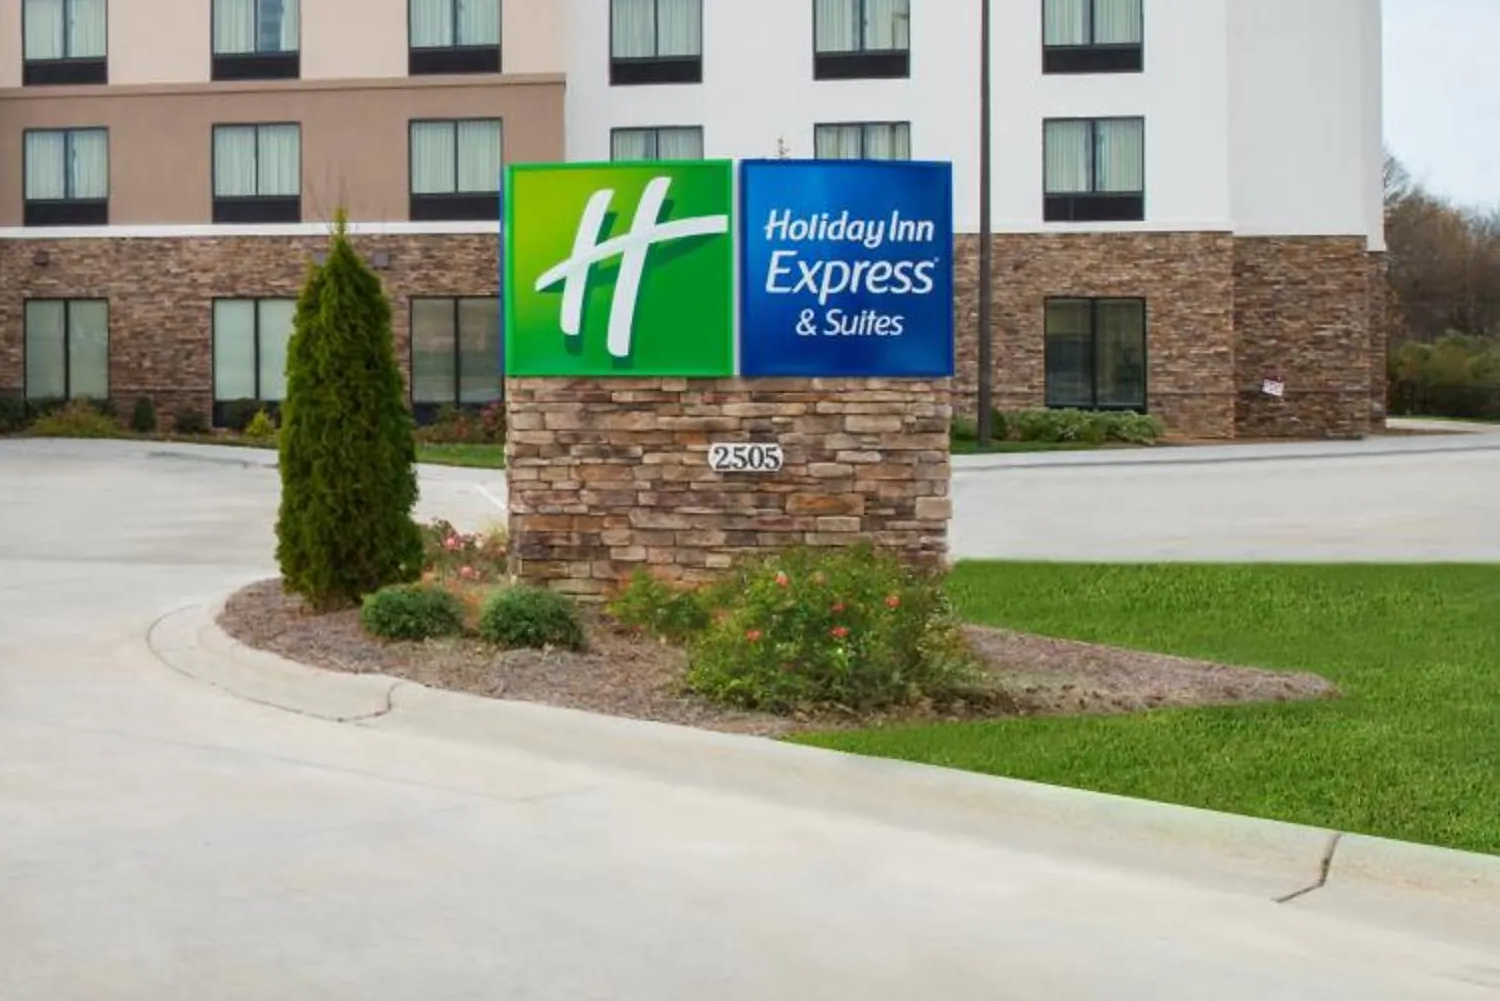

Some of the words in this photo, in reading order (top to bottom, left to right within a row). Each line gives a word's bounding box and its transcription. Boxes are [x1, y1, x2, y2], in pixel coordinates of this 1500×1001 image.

[764, 208, 885, 248] Holiday
[889, 211, 934, 242] Inn
[765, 250, 936, 305] Express
[795, 309, 818, 336] &
[823, 309, 904, 336] Suites
[713, 446, 781, 470] 2505
